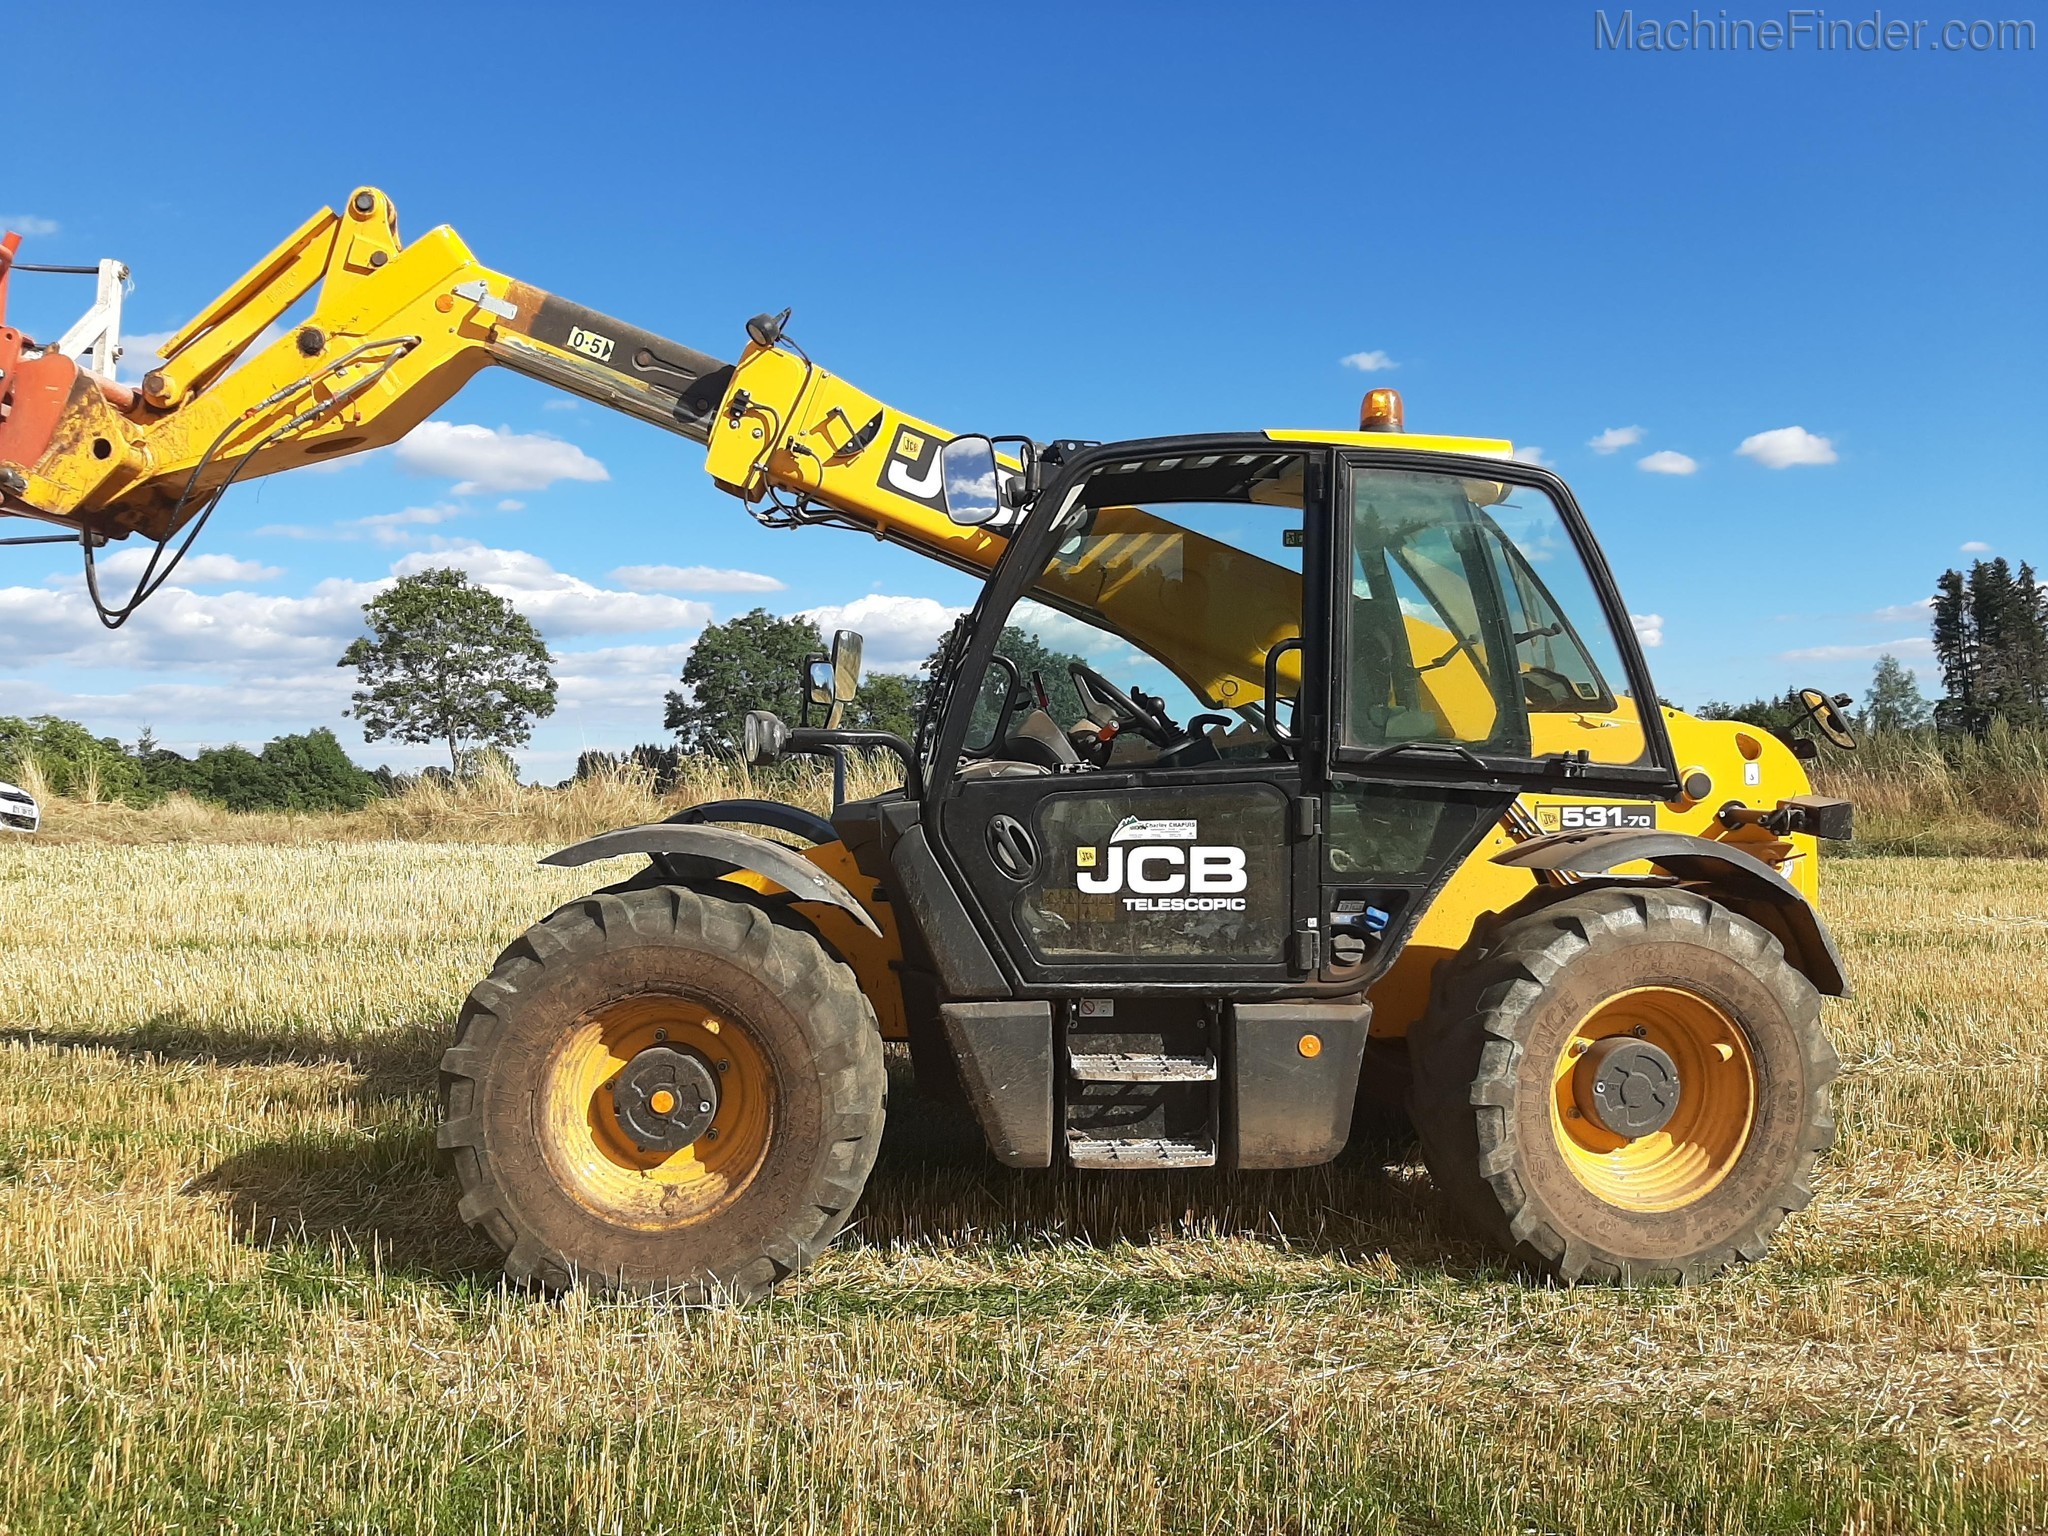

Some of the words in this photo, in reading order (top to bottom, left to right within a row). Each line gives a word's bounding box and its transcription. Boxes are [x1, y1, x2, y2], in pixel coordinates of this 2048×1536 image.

[1542, 812, 1559, 826] JCB
[1077, 846, 1248, 894] JCB
[1122, 898, 1246, 911] TELESCOPIC
[1520, 990, 1579, 1163] ALLIANCE
